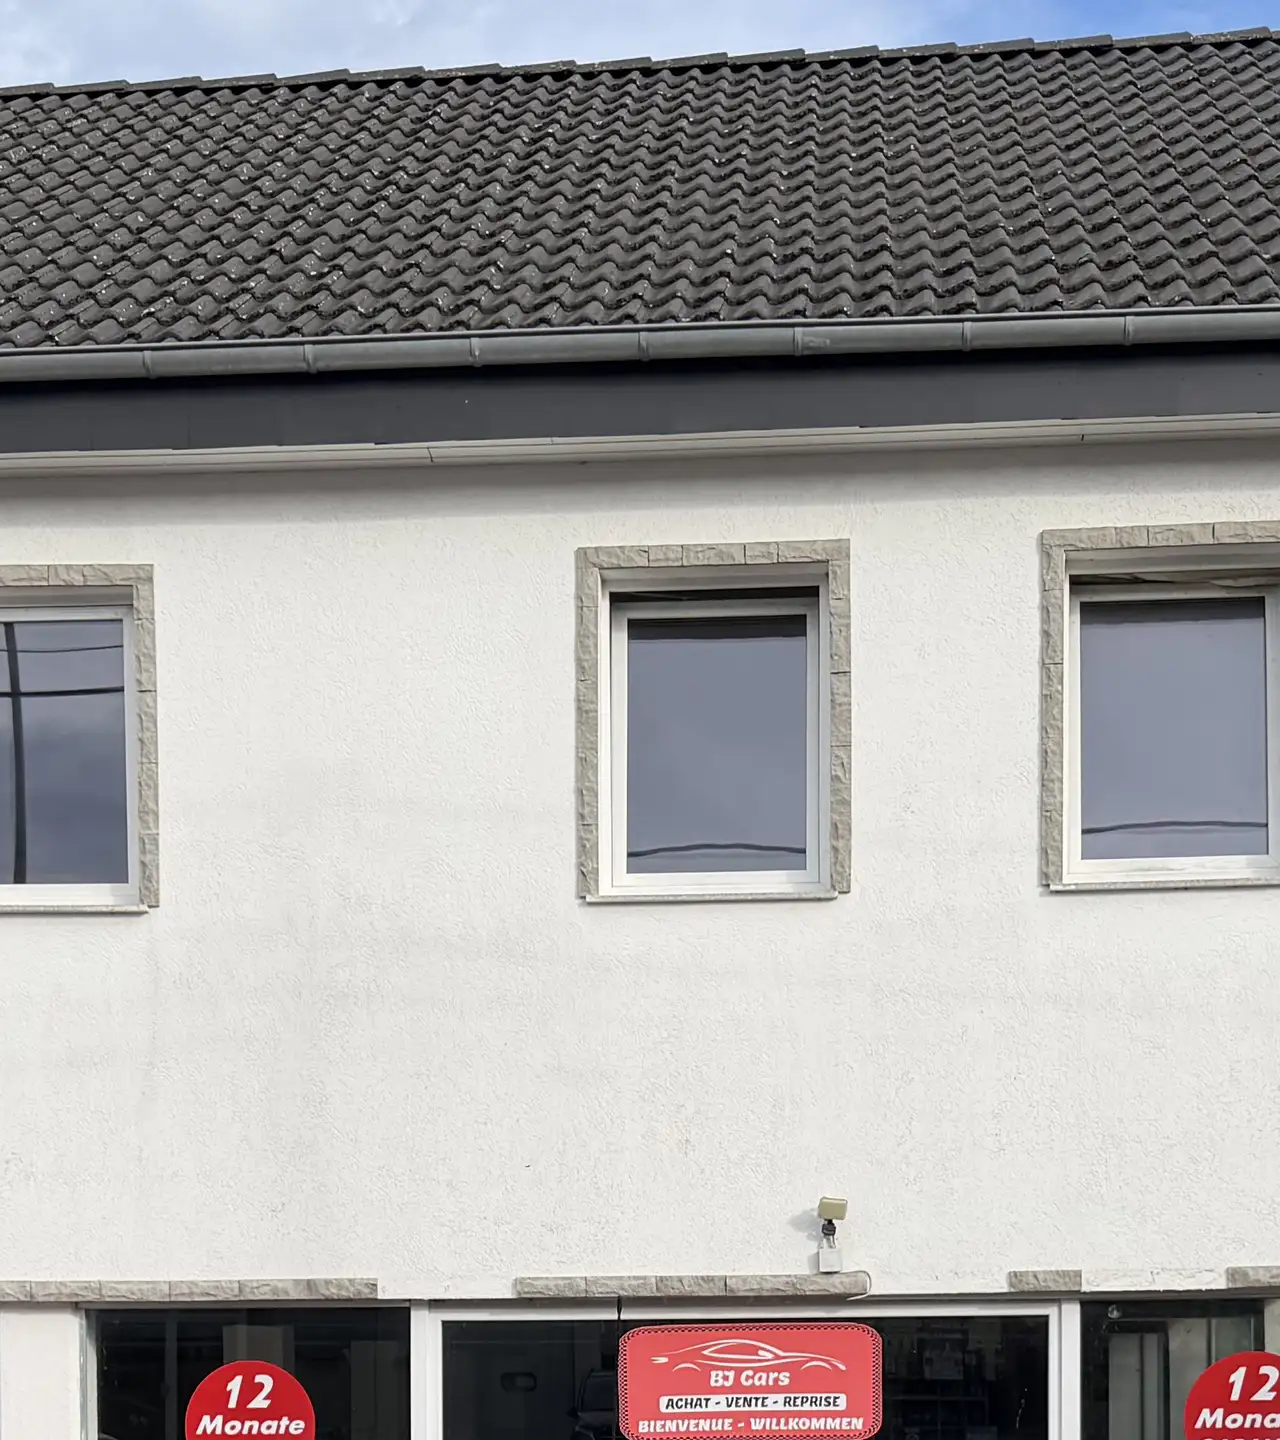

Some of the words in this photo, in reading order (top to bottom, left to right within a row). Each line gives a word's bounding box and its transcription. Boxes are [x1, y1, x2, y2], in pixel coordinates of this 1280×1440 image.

[709, 1370, 736, 1387] BJ
[739, 1370, 791, 1387] Cars
[1229, 1365, 1280, 1402] 12
[226, 1374, 274, 1409] 12
[665, 1397, 711, 1410] ACHAT
[725, 1396, 769, 1408] VENTE
[783, 1395, 841, 1408] REPRISE
[195, 1414, 306, 1436] Monate
[638, 1418, 734, 1434] BIENVENUE
[749, 1416, 864, 1431] WILLKOMMEN
